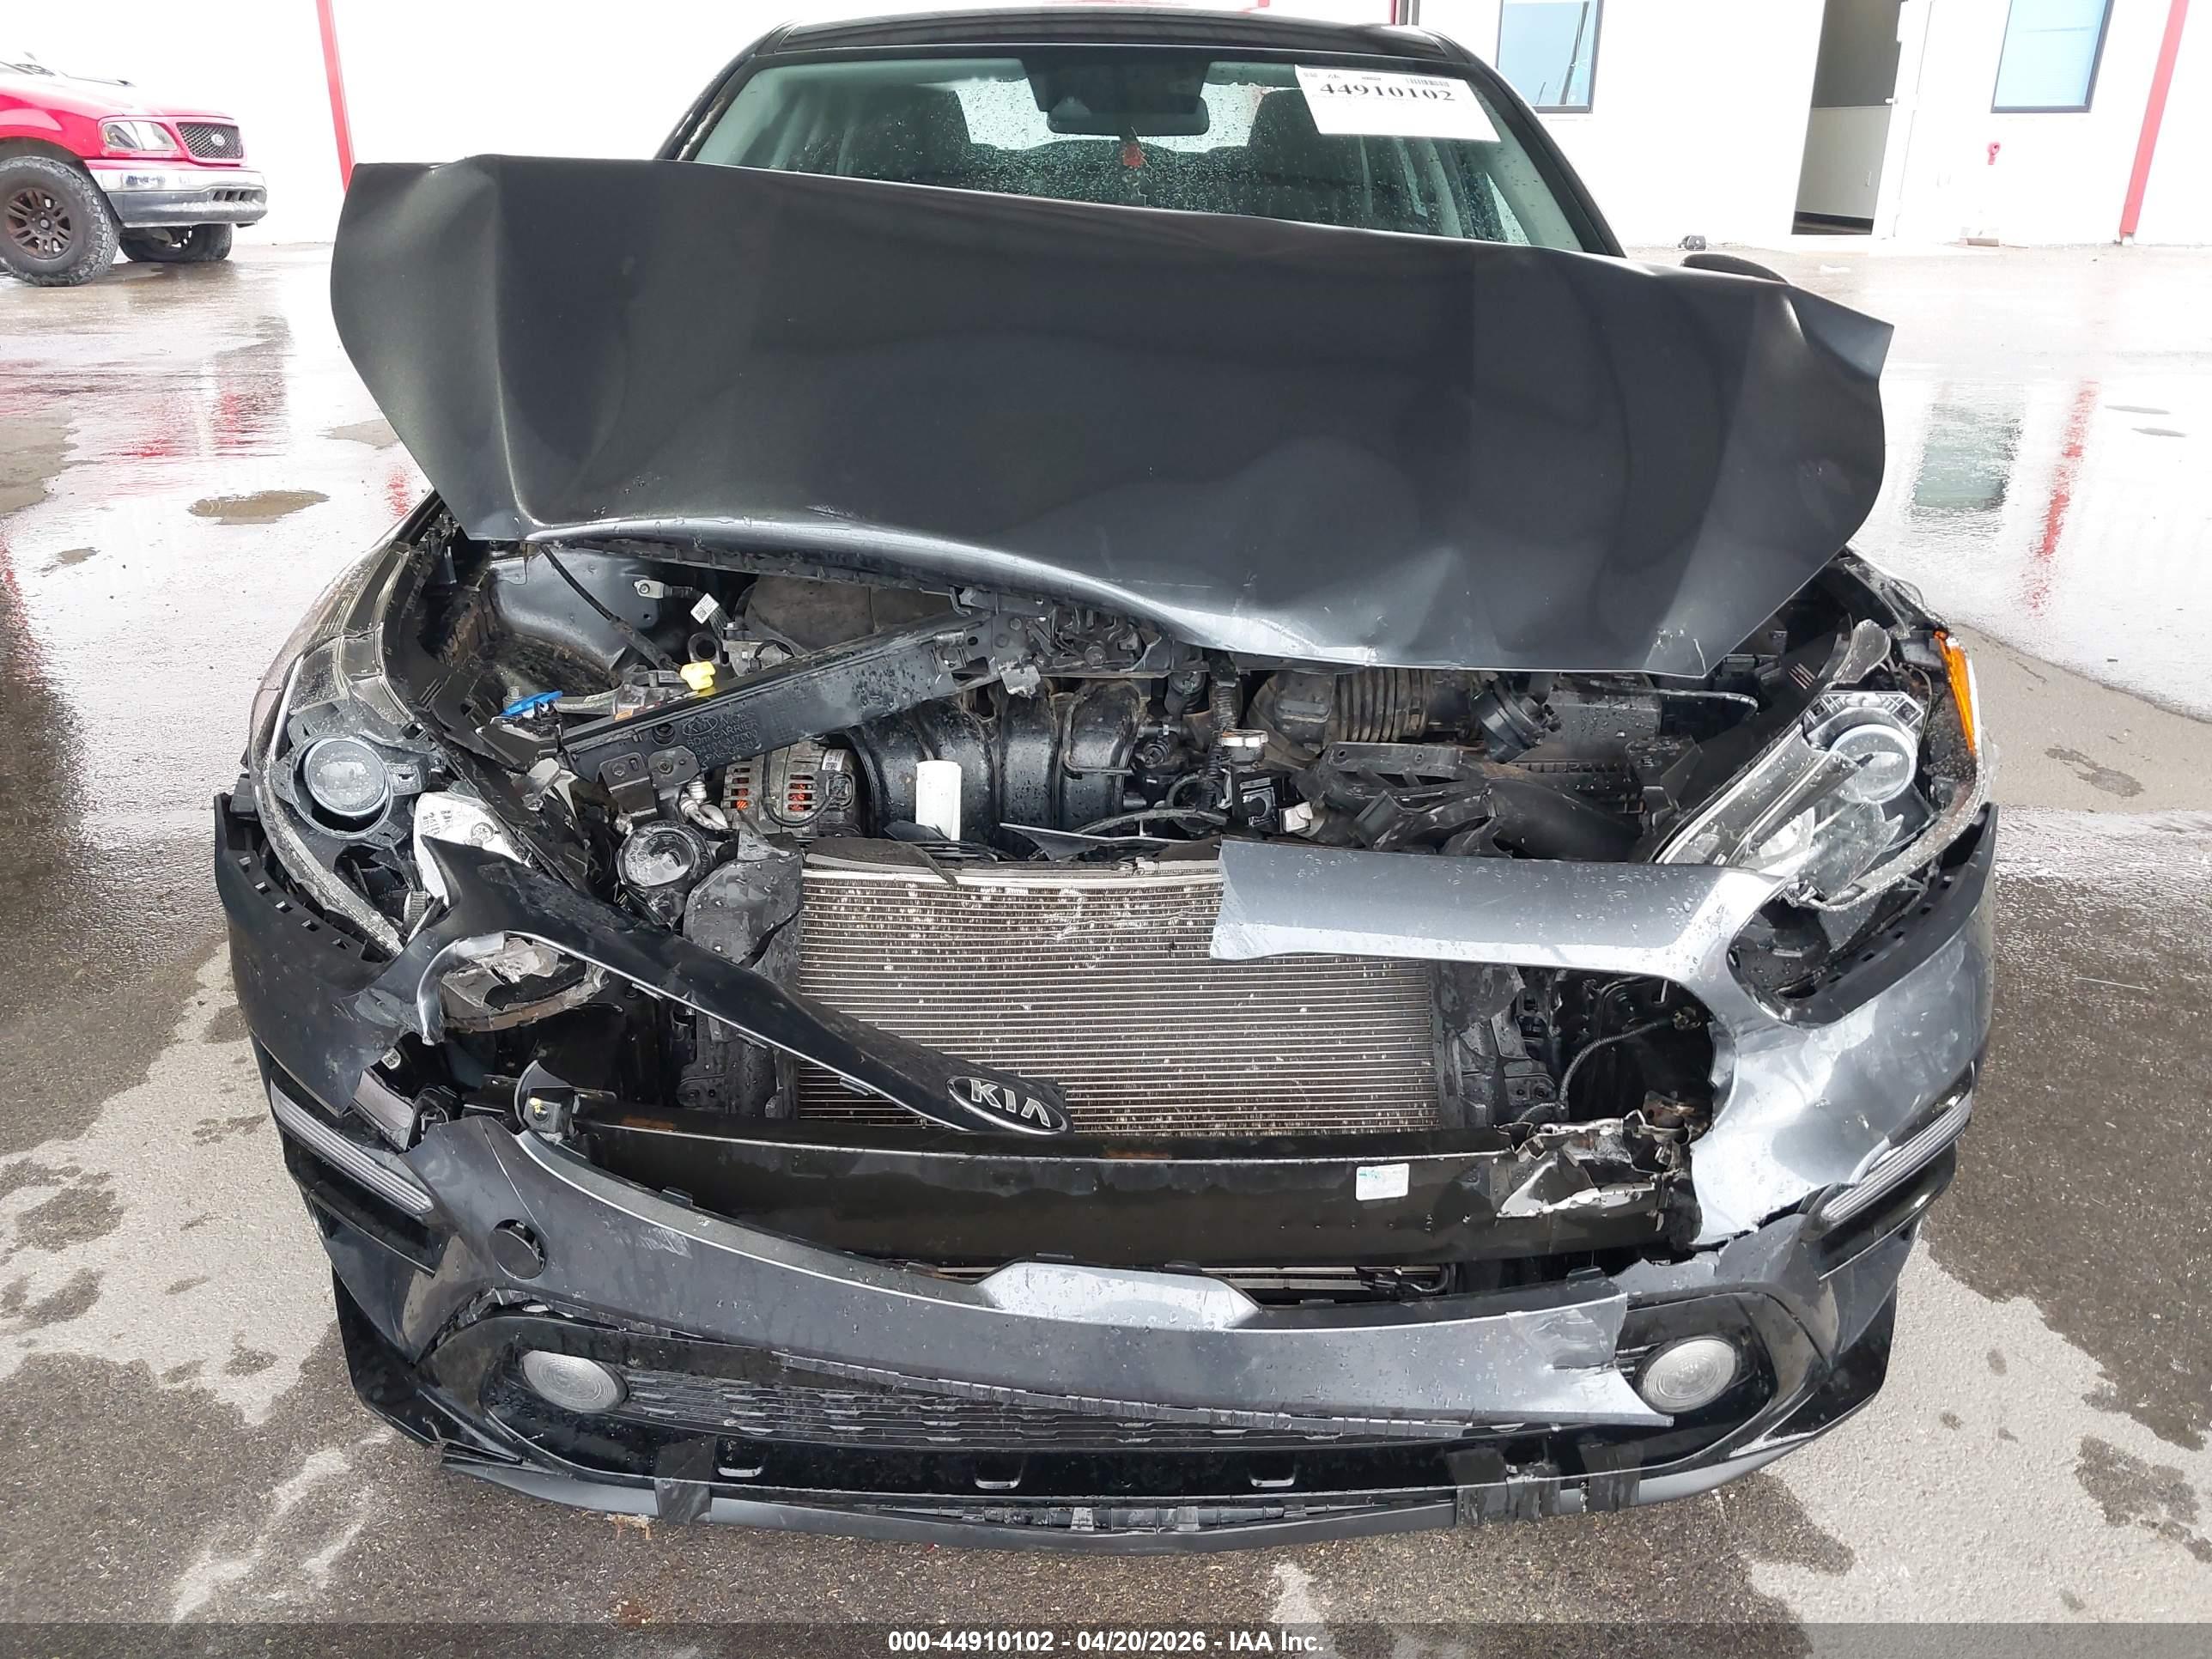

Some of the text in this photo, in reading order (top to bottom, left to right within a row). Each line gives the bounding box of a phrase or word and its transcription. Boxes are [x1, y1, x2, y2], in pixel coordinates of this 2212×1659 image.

[1320, 82, 1455, 102] 44910102
[712, 720, 758, 740] CARRIER
[968, 1078, 1051, 1128] KIA
